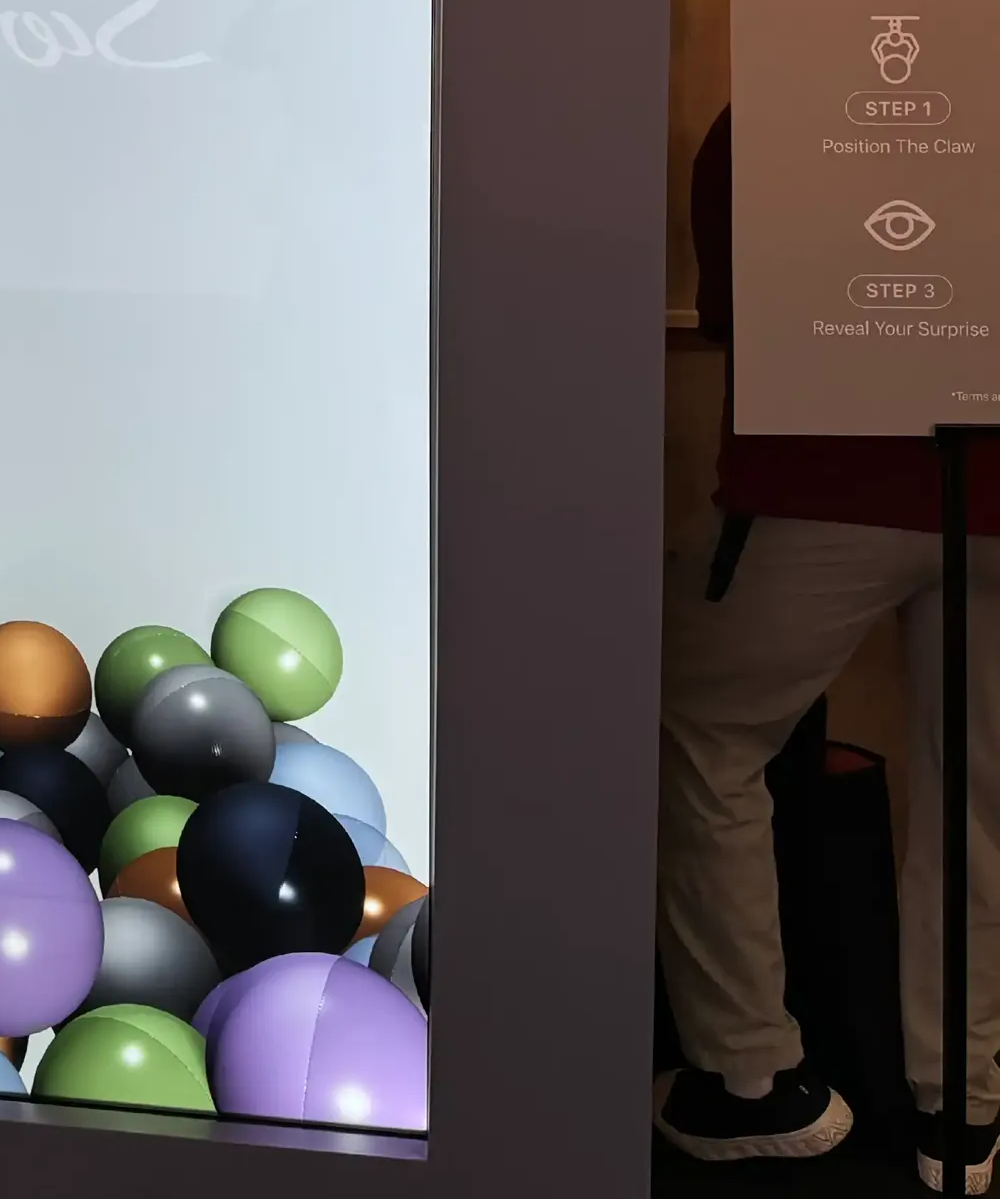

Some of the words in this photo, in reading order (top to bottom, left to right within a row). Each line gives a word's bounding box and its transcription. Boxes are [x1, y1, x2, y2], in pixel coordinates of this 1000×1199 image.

[865, 101, 916, 117] STEP
[923, 101, 931, 116] 1
[822, 138, 891, 154] Position
[896, 138, 929, 154] The
[934, 138, 976, 154] Claw
[866, 283, 917, 299] STEP
[924, 283, 935, 299] 3
[813, 320, 869, 336] Reveal
[875, 321, 914, 336] Your
[918, 321, 990, 339] Surprise
